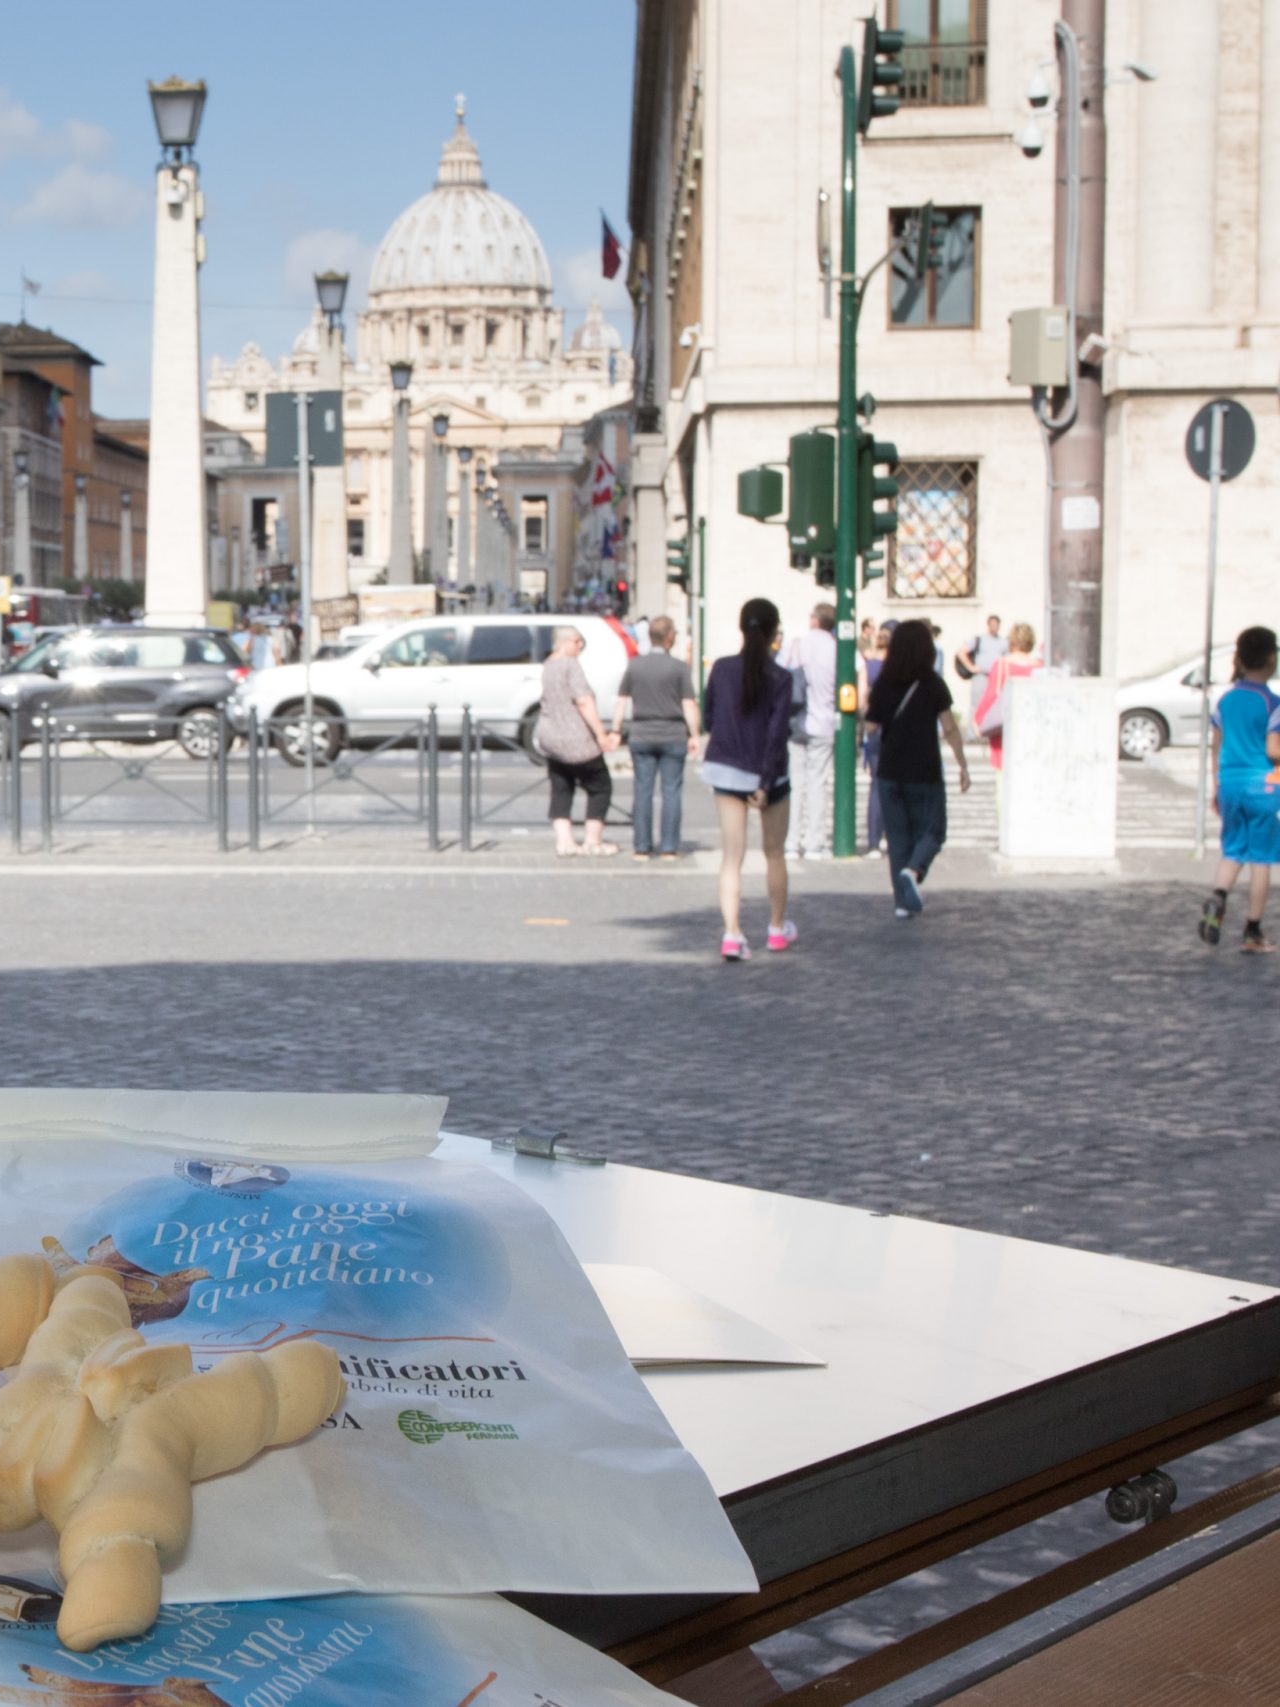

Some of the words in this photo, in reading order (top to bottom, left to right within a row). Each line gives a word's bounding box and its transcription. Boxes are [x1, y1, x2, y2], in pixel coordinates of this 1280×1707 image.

[151, 1206, 270, 1248] Dacci
[292, 1198, 415, 1229] oggi
[174, 1239, 201, 1266] il
[212, 1217, 345, 1257] nostro
[221, 1233, 378, 1281] Pane
[196, 1258, 435, 1314] quotidiano
[417, 1383, 439, 1397] di
[448, 1384, 495, 1400] vita
